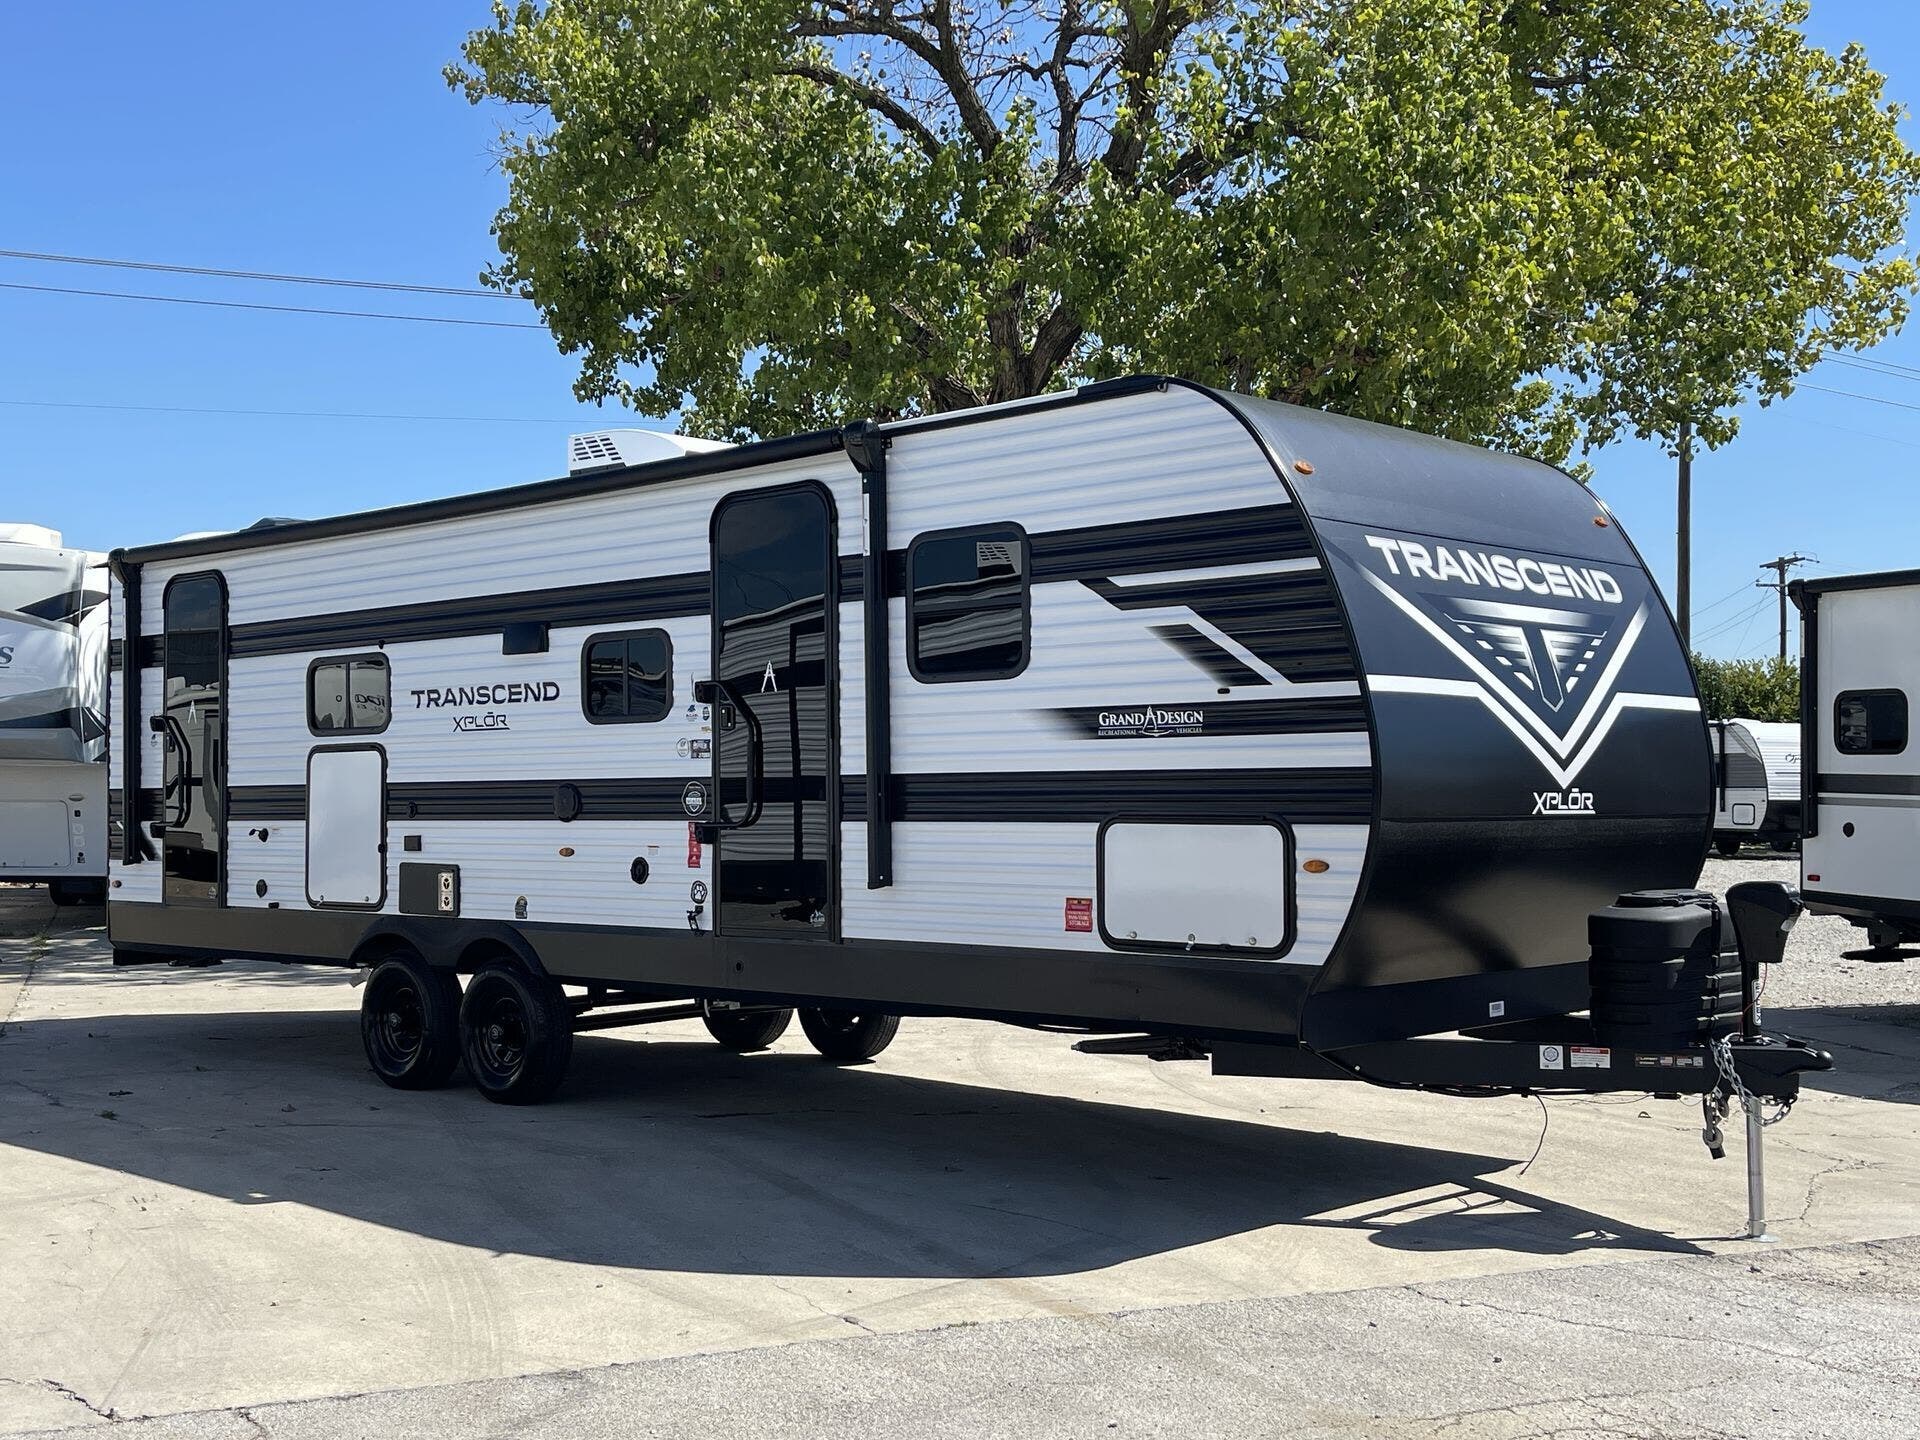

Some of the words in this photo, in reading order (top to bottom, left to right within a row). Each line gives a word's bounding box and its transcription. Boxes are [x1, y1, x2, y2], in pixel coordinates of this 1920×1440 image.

[1364, 534, 1623, 604] TRANSCEND
[410, 681, 560, 709] TRANSCEND
[1098, 711, 1145, 727] GRAND
[1155, 710, 1204, 725] DESIGN
